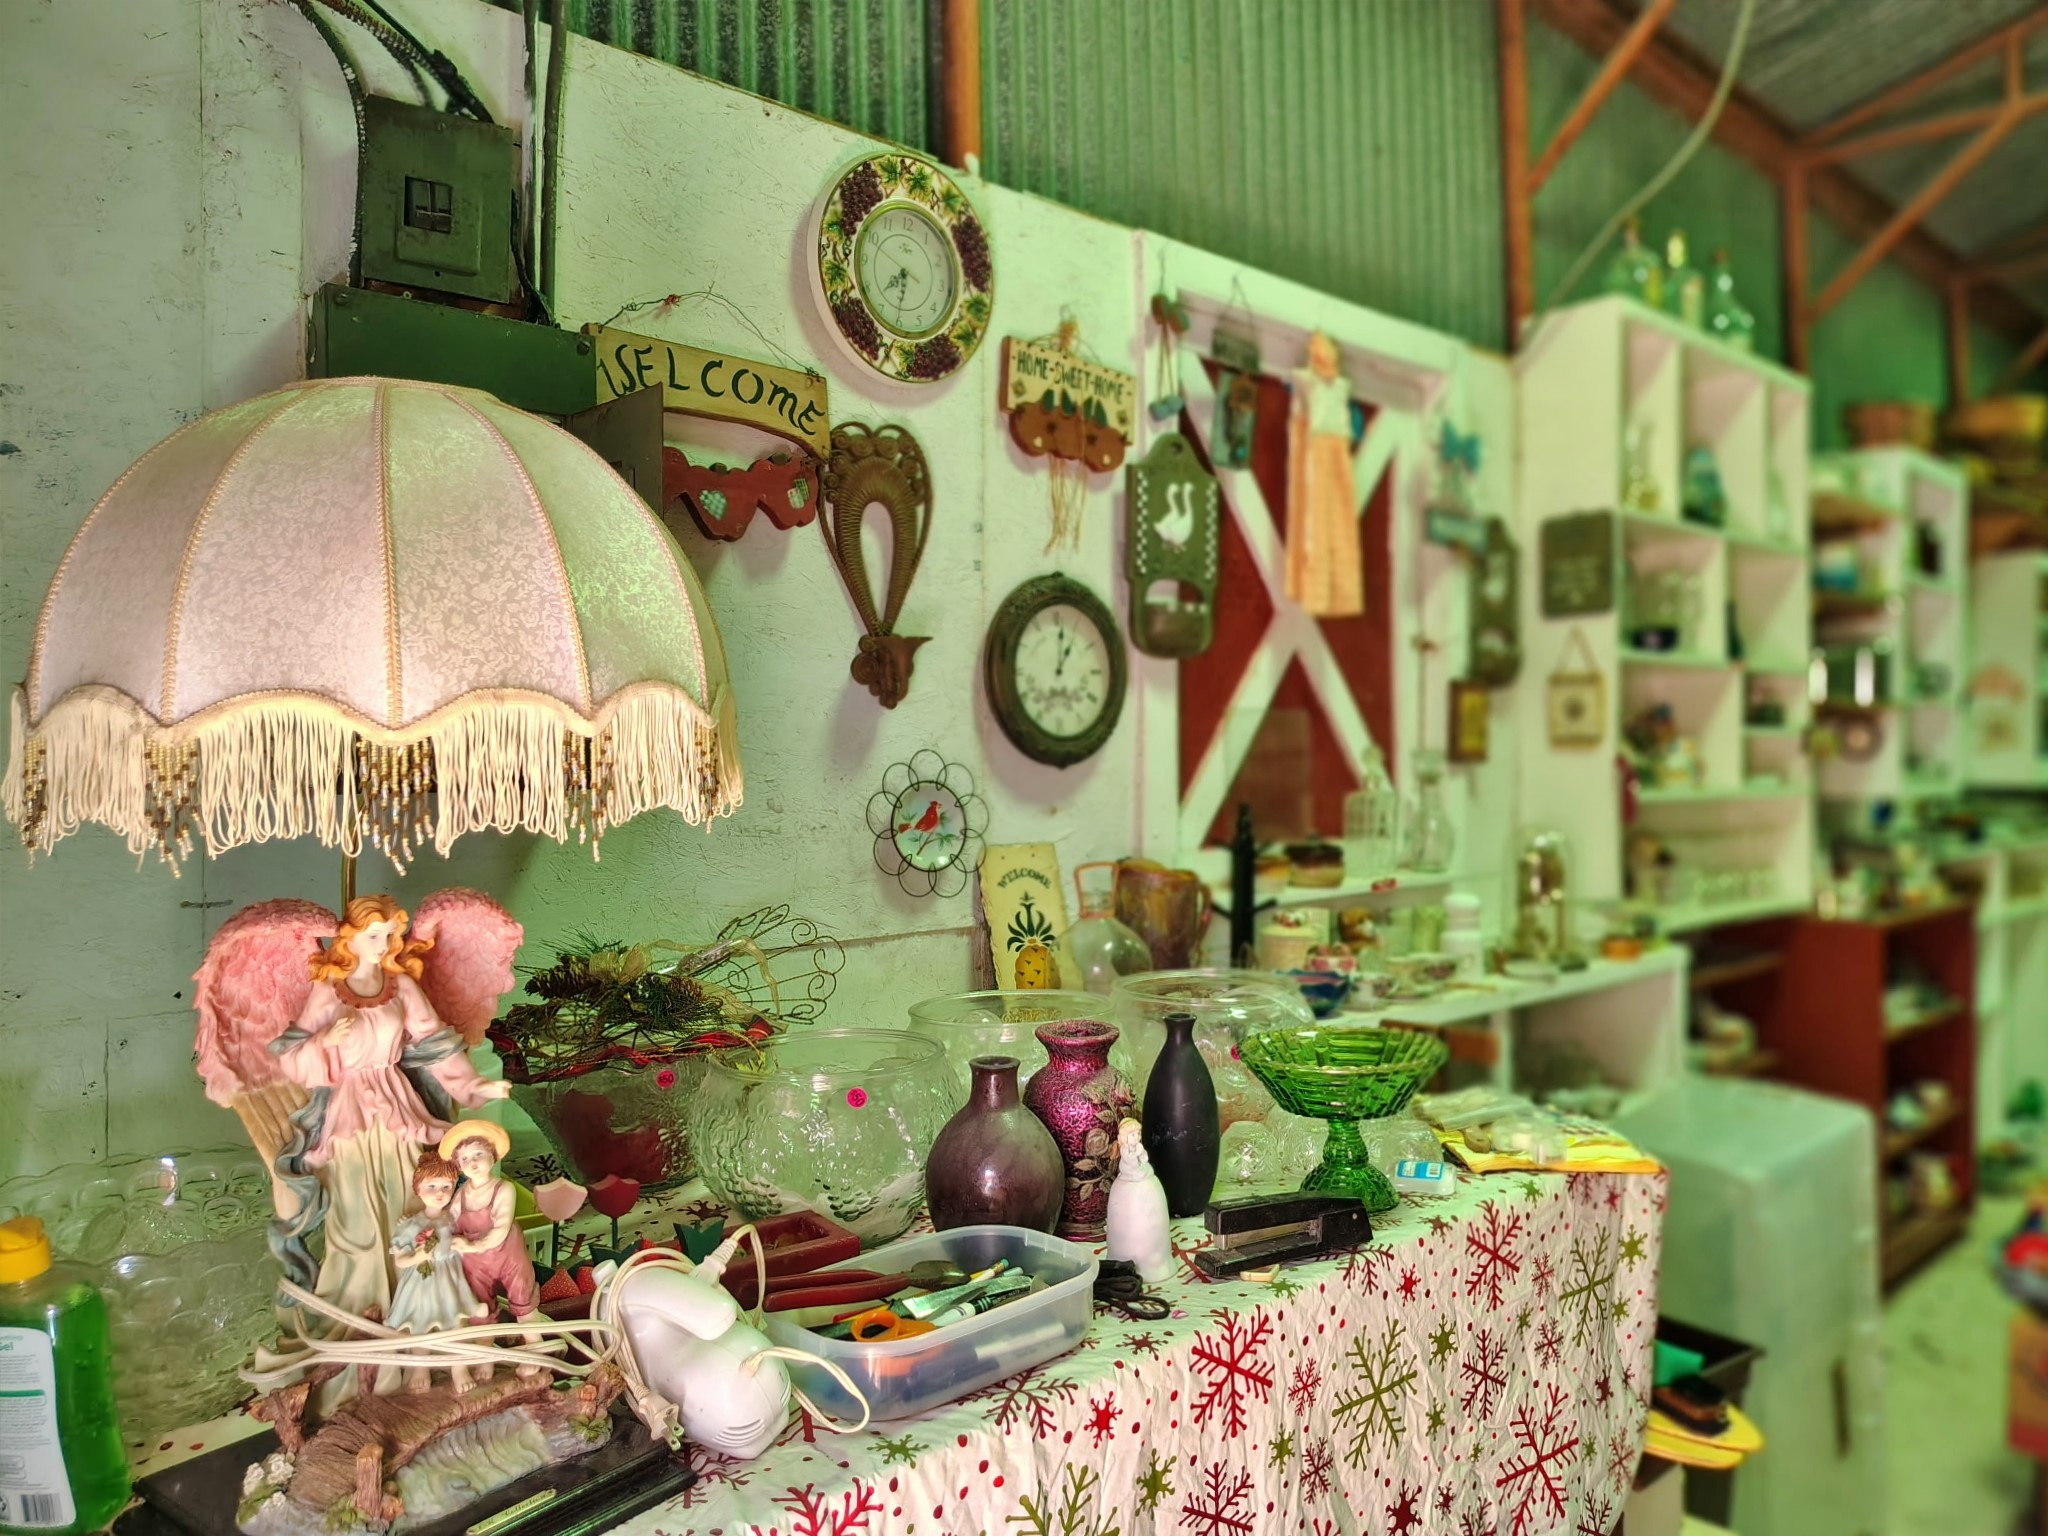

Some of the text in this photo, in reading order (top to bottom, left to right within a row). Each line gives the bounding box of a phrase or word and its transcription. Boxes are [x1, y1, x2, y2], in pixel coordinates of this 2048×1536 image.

[884, 217, 893, 231] 11
[903, 217, 914, 231] 12
[868, 231, 879, 246] 10
[997, 867, 1052, 890] WELCOME
